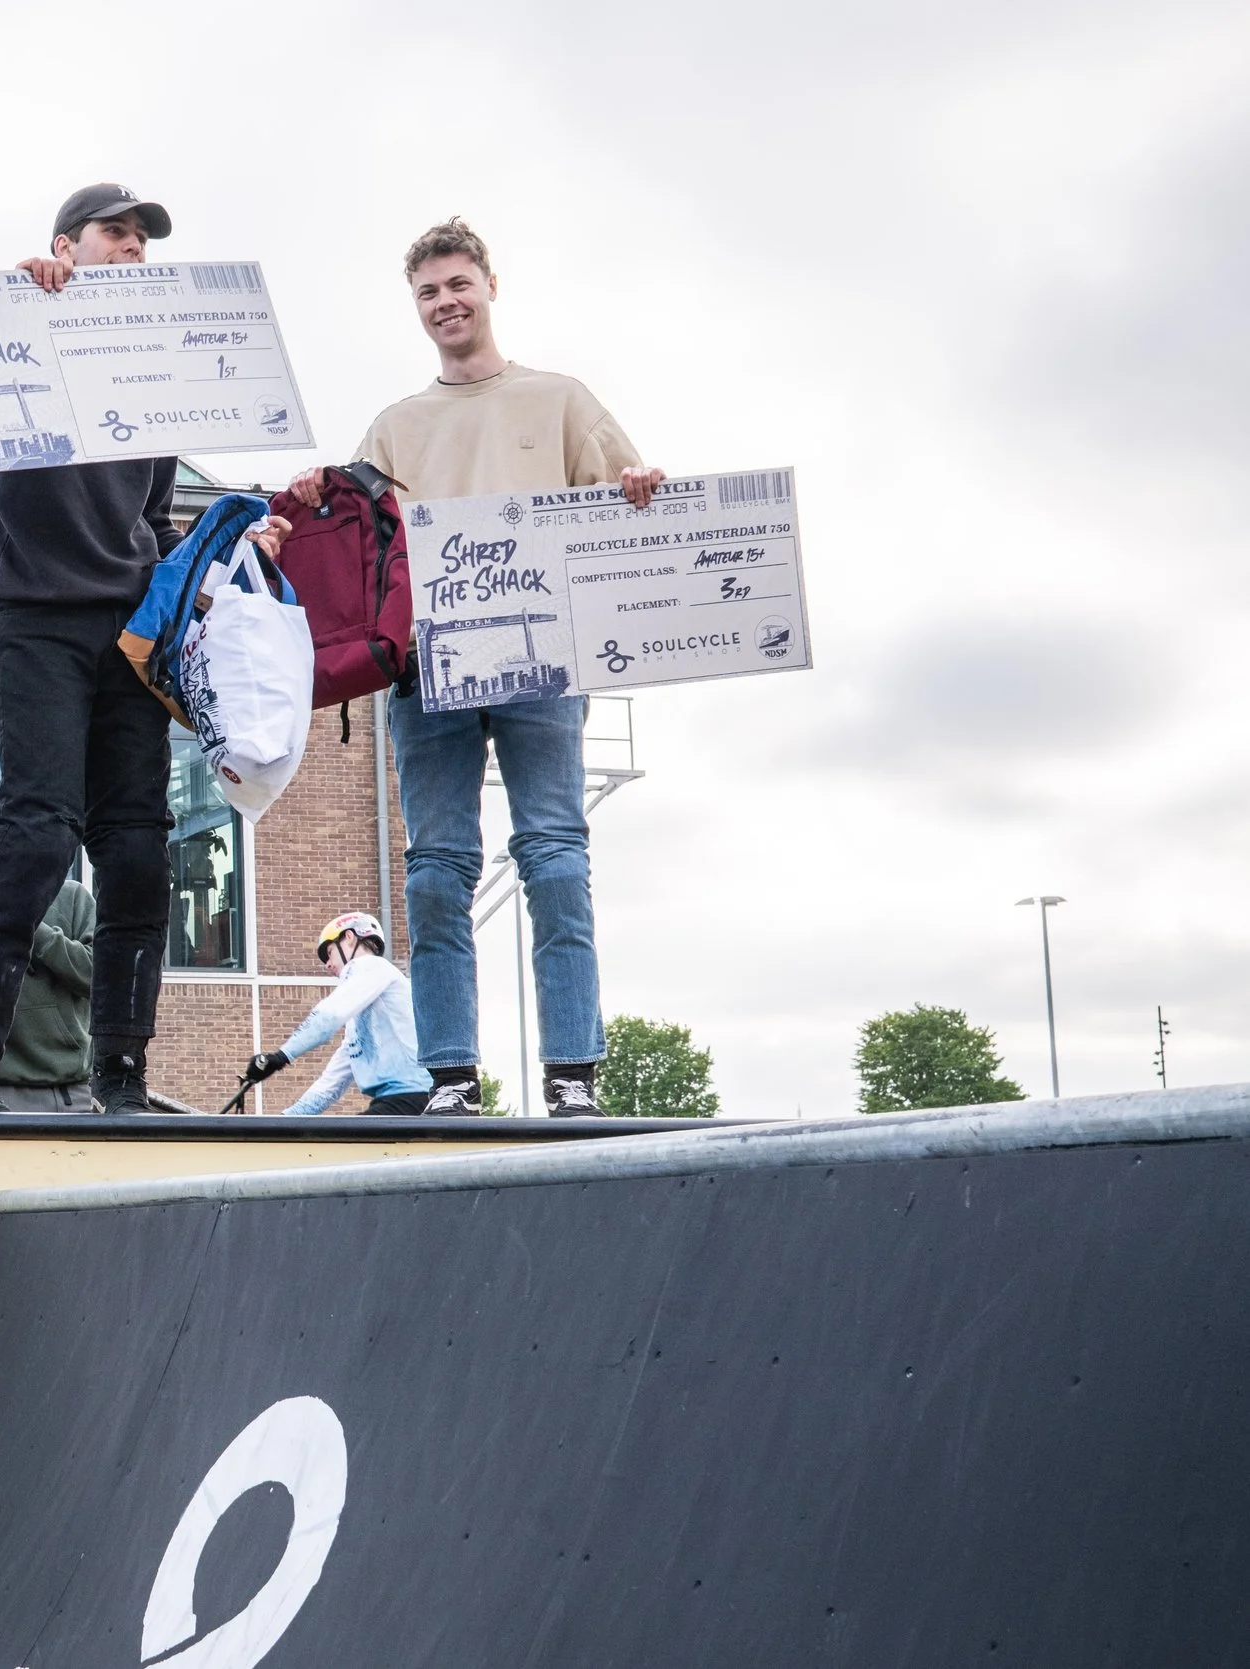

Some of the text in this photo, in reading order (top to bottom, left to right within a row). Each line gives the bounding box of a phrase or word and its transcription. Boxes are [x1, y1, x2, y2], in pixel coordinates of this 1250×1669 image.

[84, 267, 179, 280] SOULCYCLE
[10, 285, 185, 304] OFFICIAL CHECK 24134 2009 41
[48, 311, 268, 329] SOULCYCLE BMX X AMSTERDAM 750
[59, 330, 249, 357] COMPETITION CLASS: AMATEUR 15+
[112, 354, 237, 384] PLACEMENT: 1ST
[143, 408, 242, 425] SOULCYCLE
[531, 492, 580, 507] BANK
[584, 489, 605, 502] OF
[533, 512, 583, 528] OFFICIAL
[588, 508, 620, 523] CHECK
[662, 502, 688, 516] 2009
[693, 500, 707, 512] 43
[565, 523, 791, 554] SOULCYCLE BMX X AMSTERDAM 750
[440, 532, 518, 574] SHRED
[571, 547, 765, 585] COMPETITION CLASS: AMATEUR 15+
[422, 565, 552, 613] THE SHACK
[617, 576, 751, 613] PLACEMENT: 3RD
[642, 631, 741, 654] SOULCYCLE
